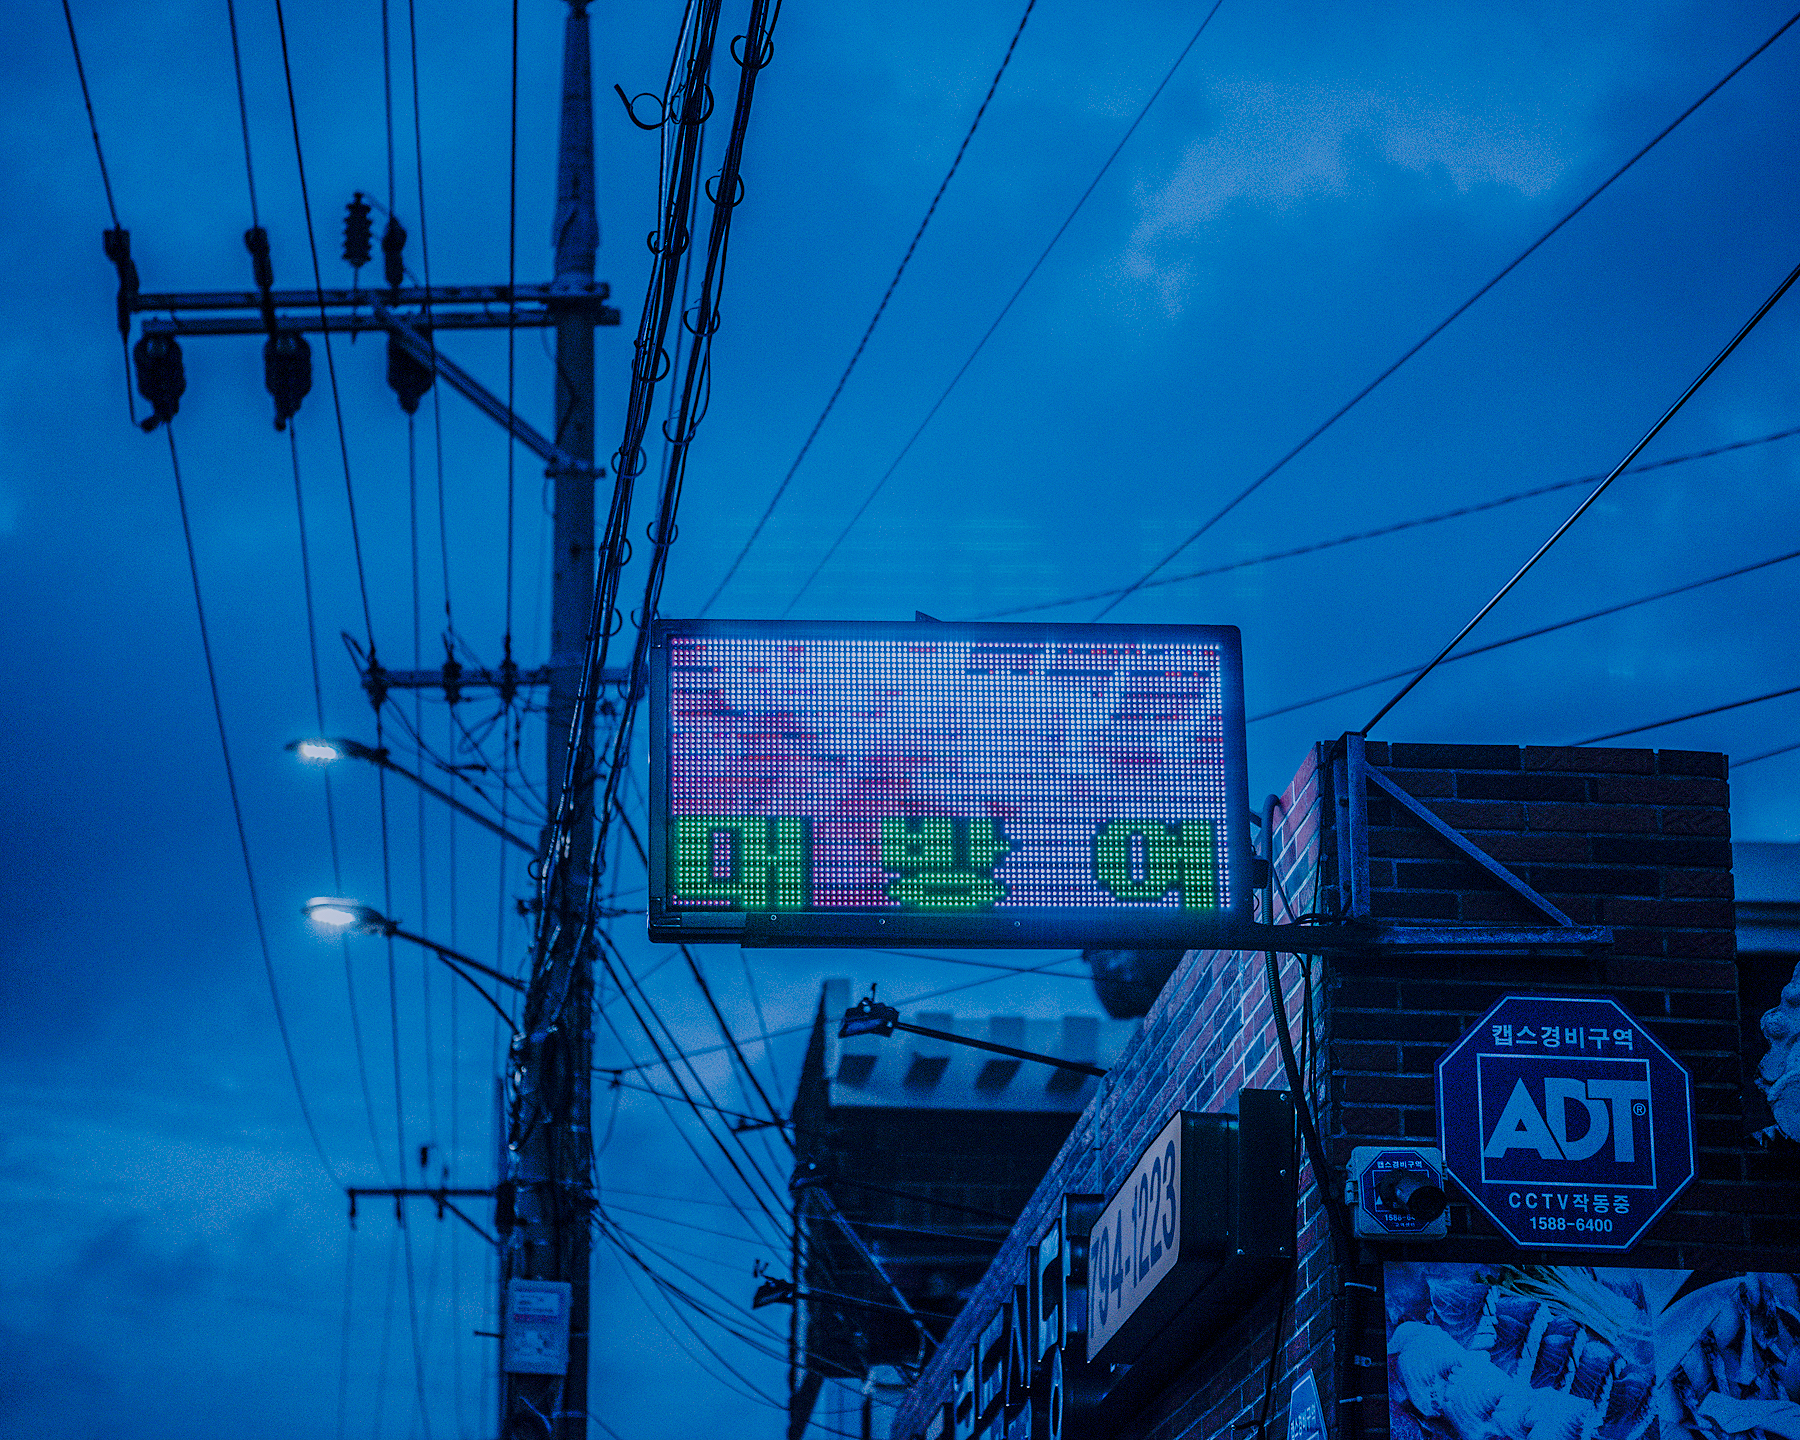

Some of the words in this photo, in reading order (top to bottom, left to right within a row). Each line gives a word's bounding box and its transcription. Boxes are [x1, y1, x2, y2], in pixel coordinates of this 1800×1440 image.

[1492, 1025, 1634, 1050] 캡스경비구역
[1509, 1192, 1630, 1214] CCTV작동중
[1530, 1217, 1613, 1233] 1588-6400
[1090, 1140, 1177, 1339] 794-1223
